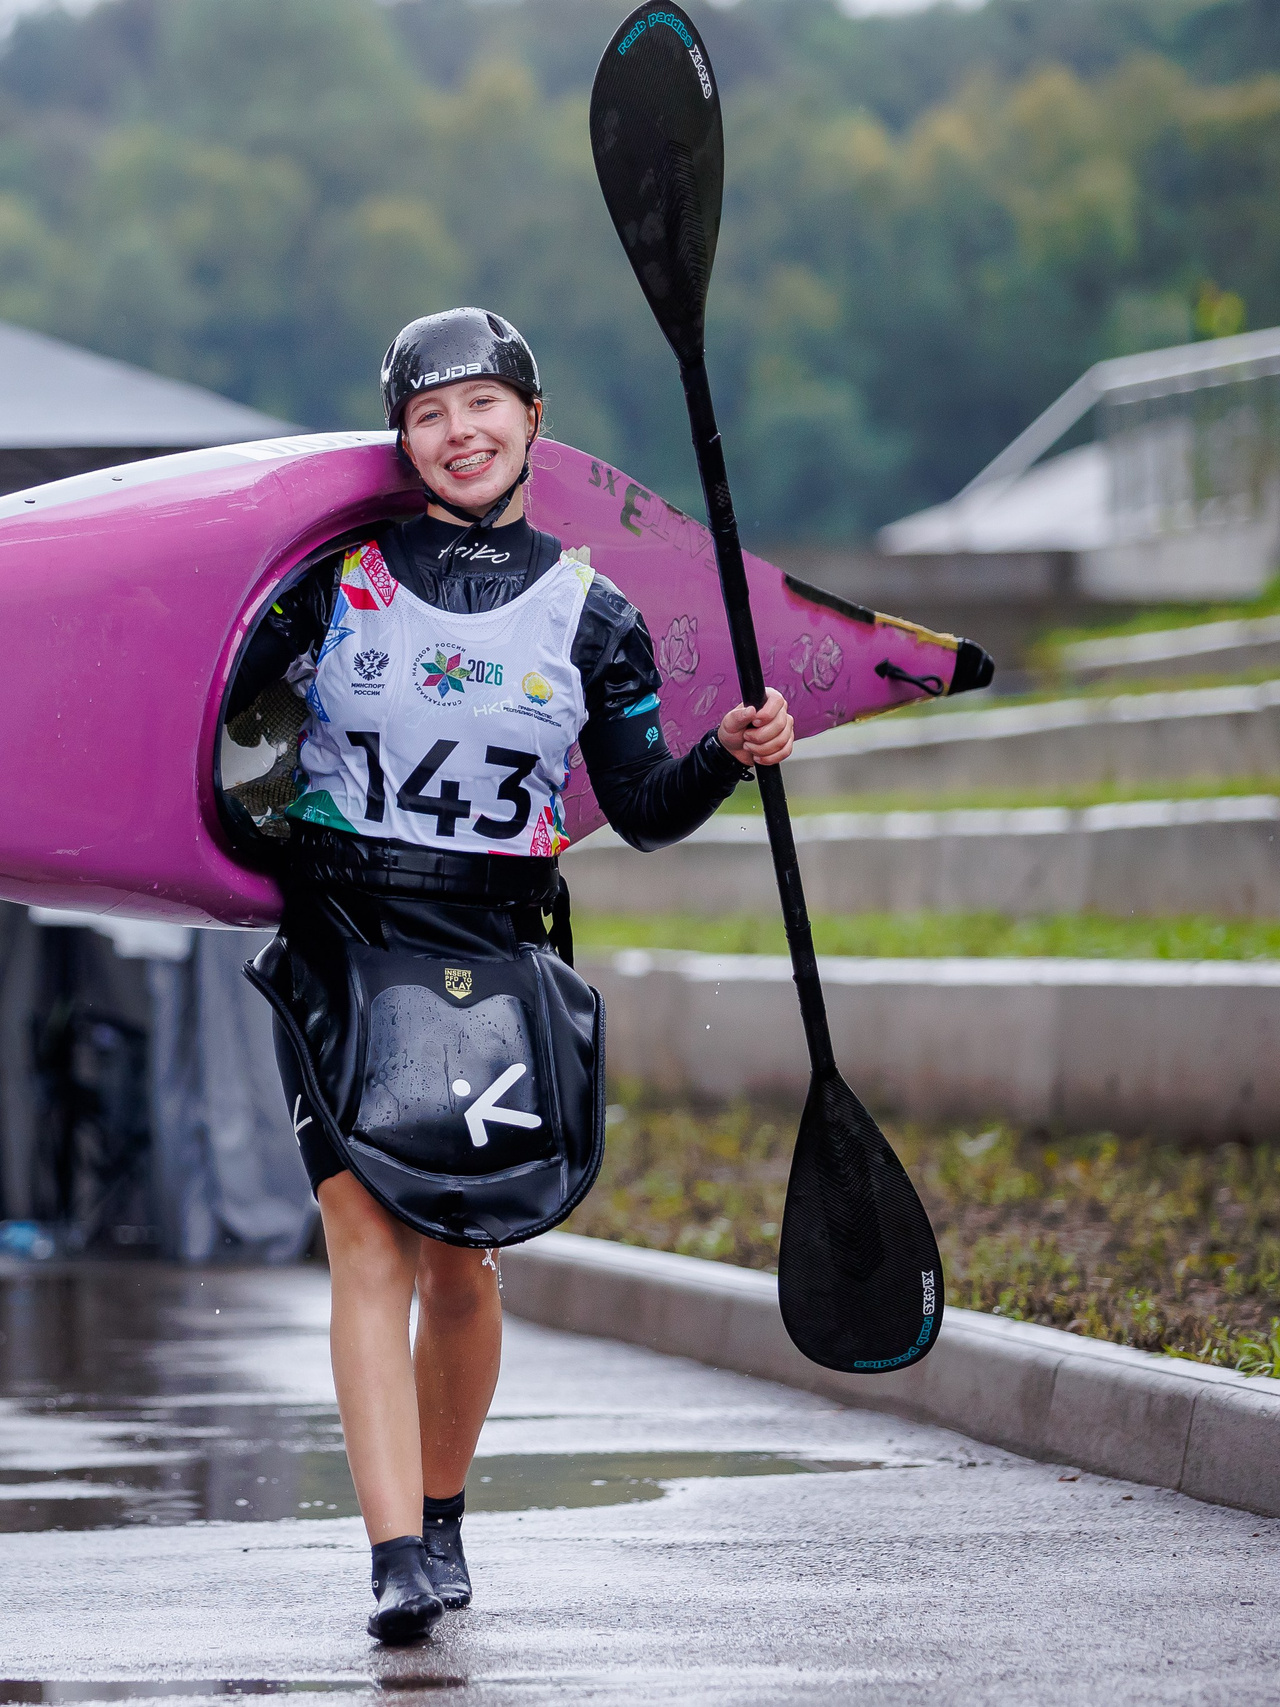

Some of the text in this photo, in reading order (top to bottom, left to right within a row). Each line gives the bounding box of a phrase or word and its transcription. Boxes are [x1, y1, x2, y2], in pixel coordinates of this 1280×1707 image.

[618, 12, 693, 55] raab paddles
[412, 646, 431, 676] НАРОДОВ
[435, 642, 467, 653] РОССИИ
[351, 682, 386, 690] МИНСПОРТ
[466, 659, 504, 687] 2026
[414, 681, 462, 707] СПАРТАКИАДА
[345, 730, 542, 840] 143
[445, 969, 472, 978] INSERT
[445, 981, 473, 990] PLAY
[853, 1316, 934, 1369] raab paddles
